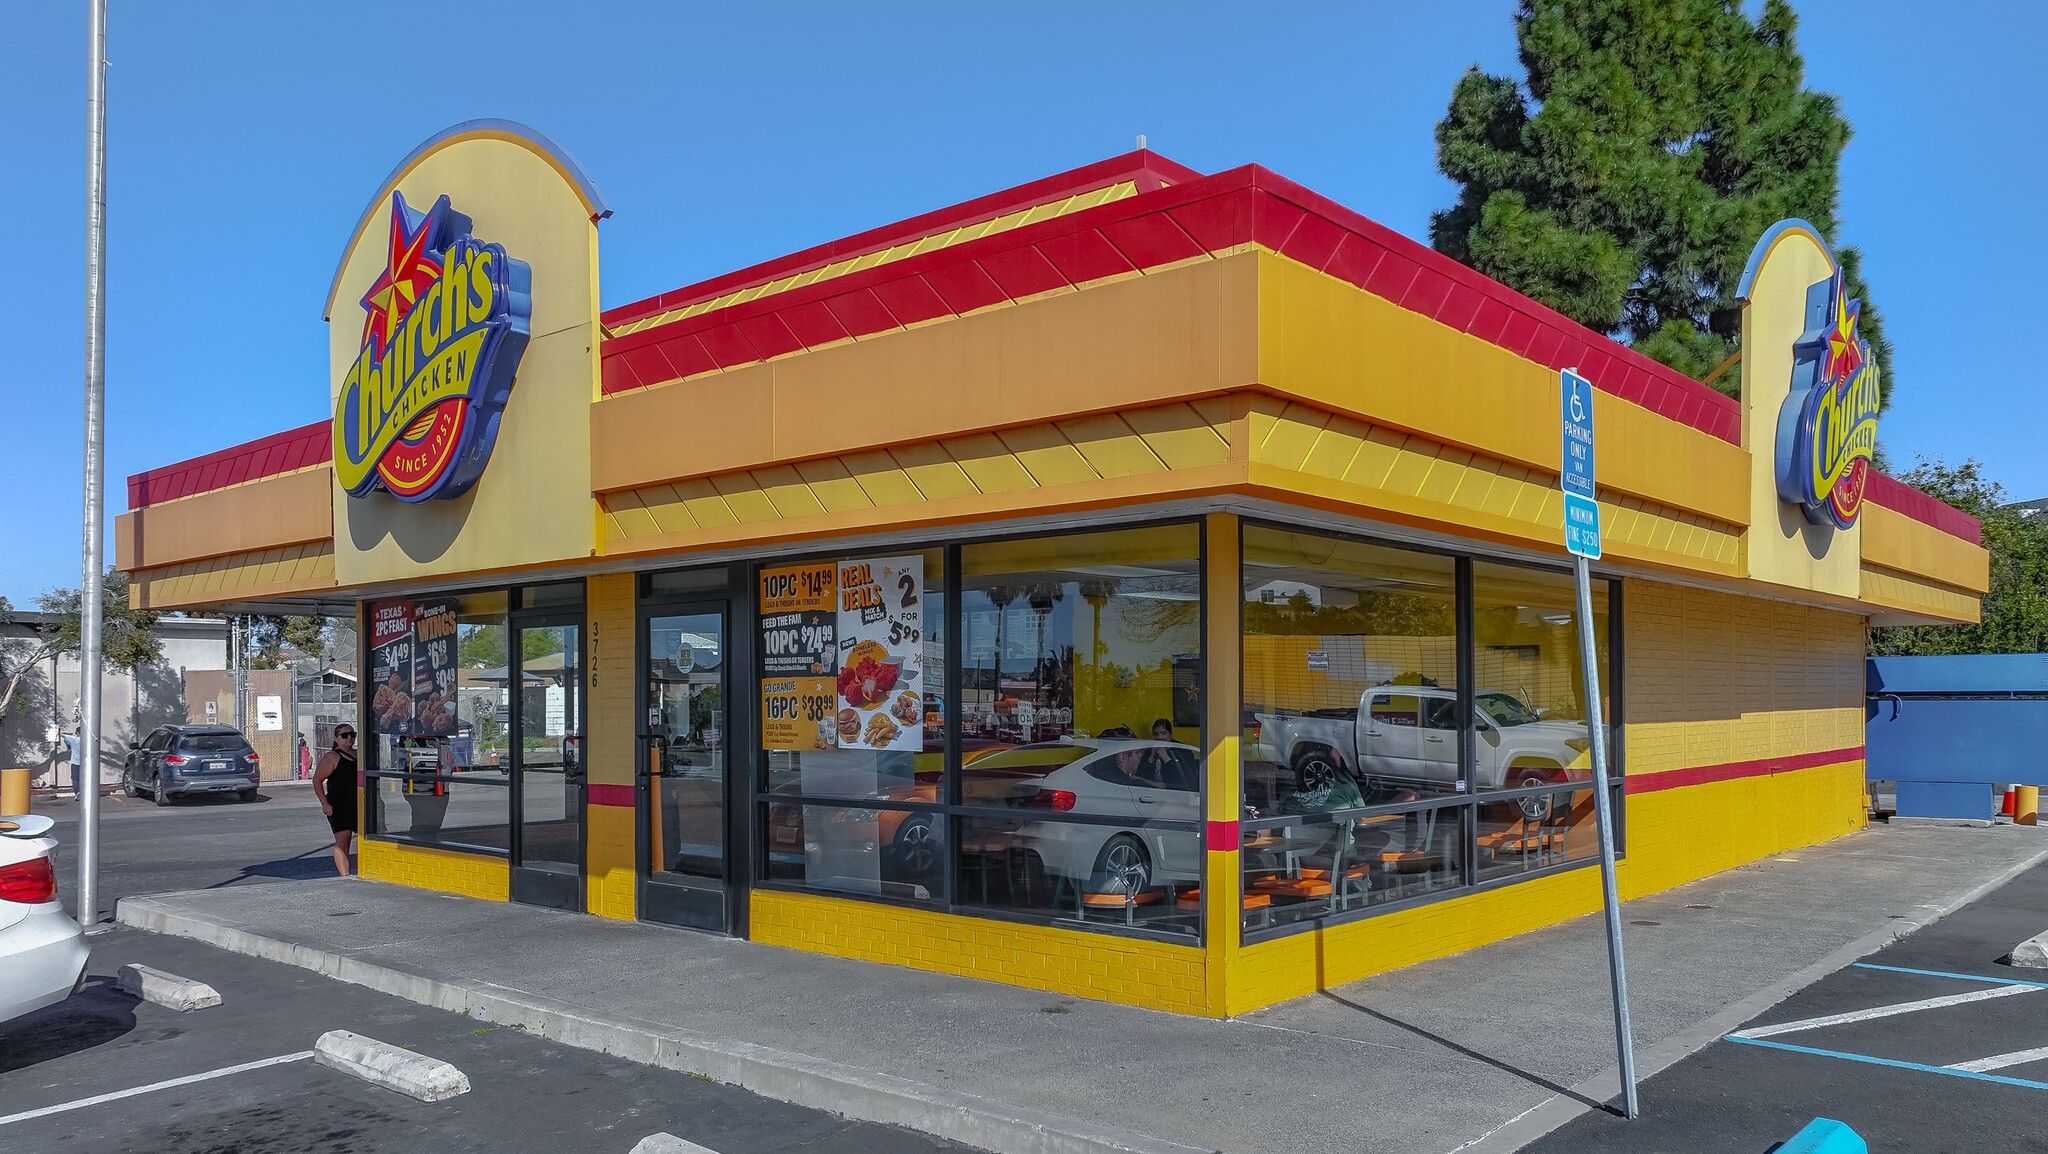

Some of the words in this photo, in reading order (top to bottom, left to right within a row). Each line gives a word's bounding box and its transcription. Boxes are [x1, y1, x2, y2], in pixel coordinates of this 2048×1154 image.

[335, 245, 494, 490] Church's
[392, 350, 467, 430] CHICKEN
[1565, 420, 1592, 445] PARKING
[1813, 348, 1881, 500] Church's
[394, 455, 428, 474] SINCE
[431, 413, 452, 456] 1952
[1570, 441, 1587, 461] ONLY
[1842, 427, 1872, 464] CHICKEN
[1574, 461, 1584, 473] VAN
[1565, 471, 1591, 490] ACCESSIBLE
[1838, 485, 1854, 504] SINCE
[1570, 505, 1594, 526] MINIMUM
[1568, 524, 1580, 543] FINE
[1582, 529, 1598, 548] $250
[841, 563, 874, 589] REAL
[898, 567, 911, 576] ANY
[763, 573, 798, 599] 10PC
[841, 584, 882, 612] DEALS
[898, 574, 918, 609] 2
[380, 606, 402, 620] TEXAS
[762, 616, 776, 629] FEED
[777, 615, 788, 627] THE
[788, 613, 802, 625] FAM
[865, 612, 884, 621] MATCH
[901, 613, 918, 621] FOR
[375, 620, 388, 637] 2PC
[388, 617, 407, 634] FEAST
[417, 611, 457, 642] WINGS
[763, 629, 799, 655] 10PC
[857, 648, 874, 656] WINGS
[764, 684, 772, 694] GO
[772, 681, 796, 693] GRANDE
[765, 696, 799, 720] 16PC
